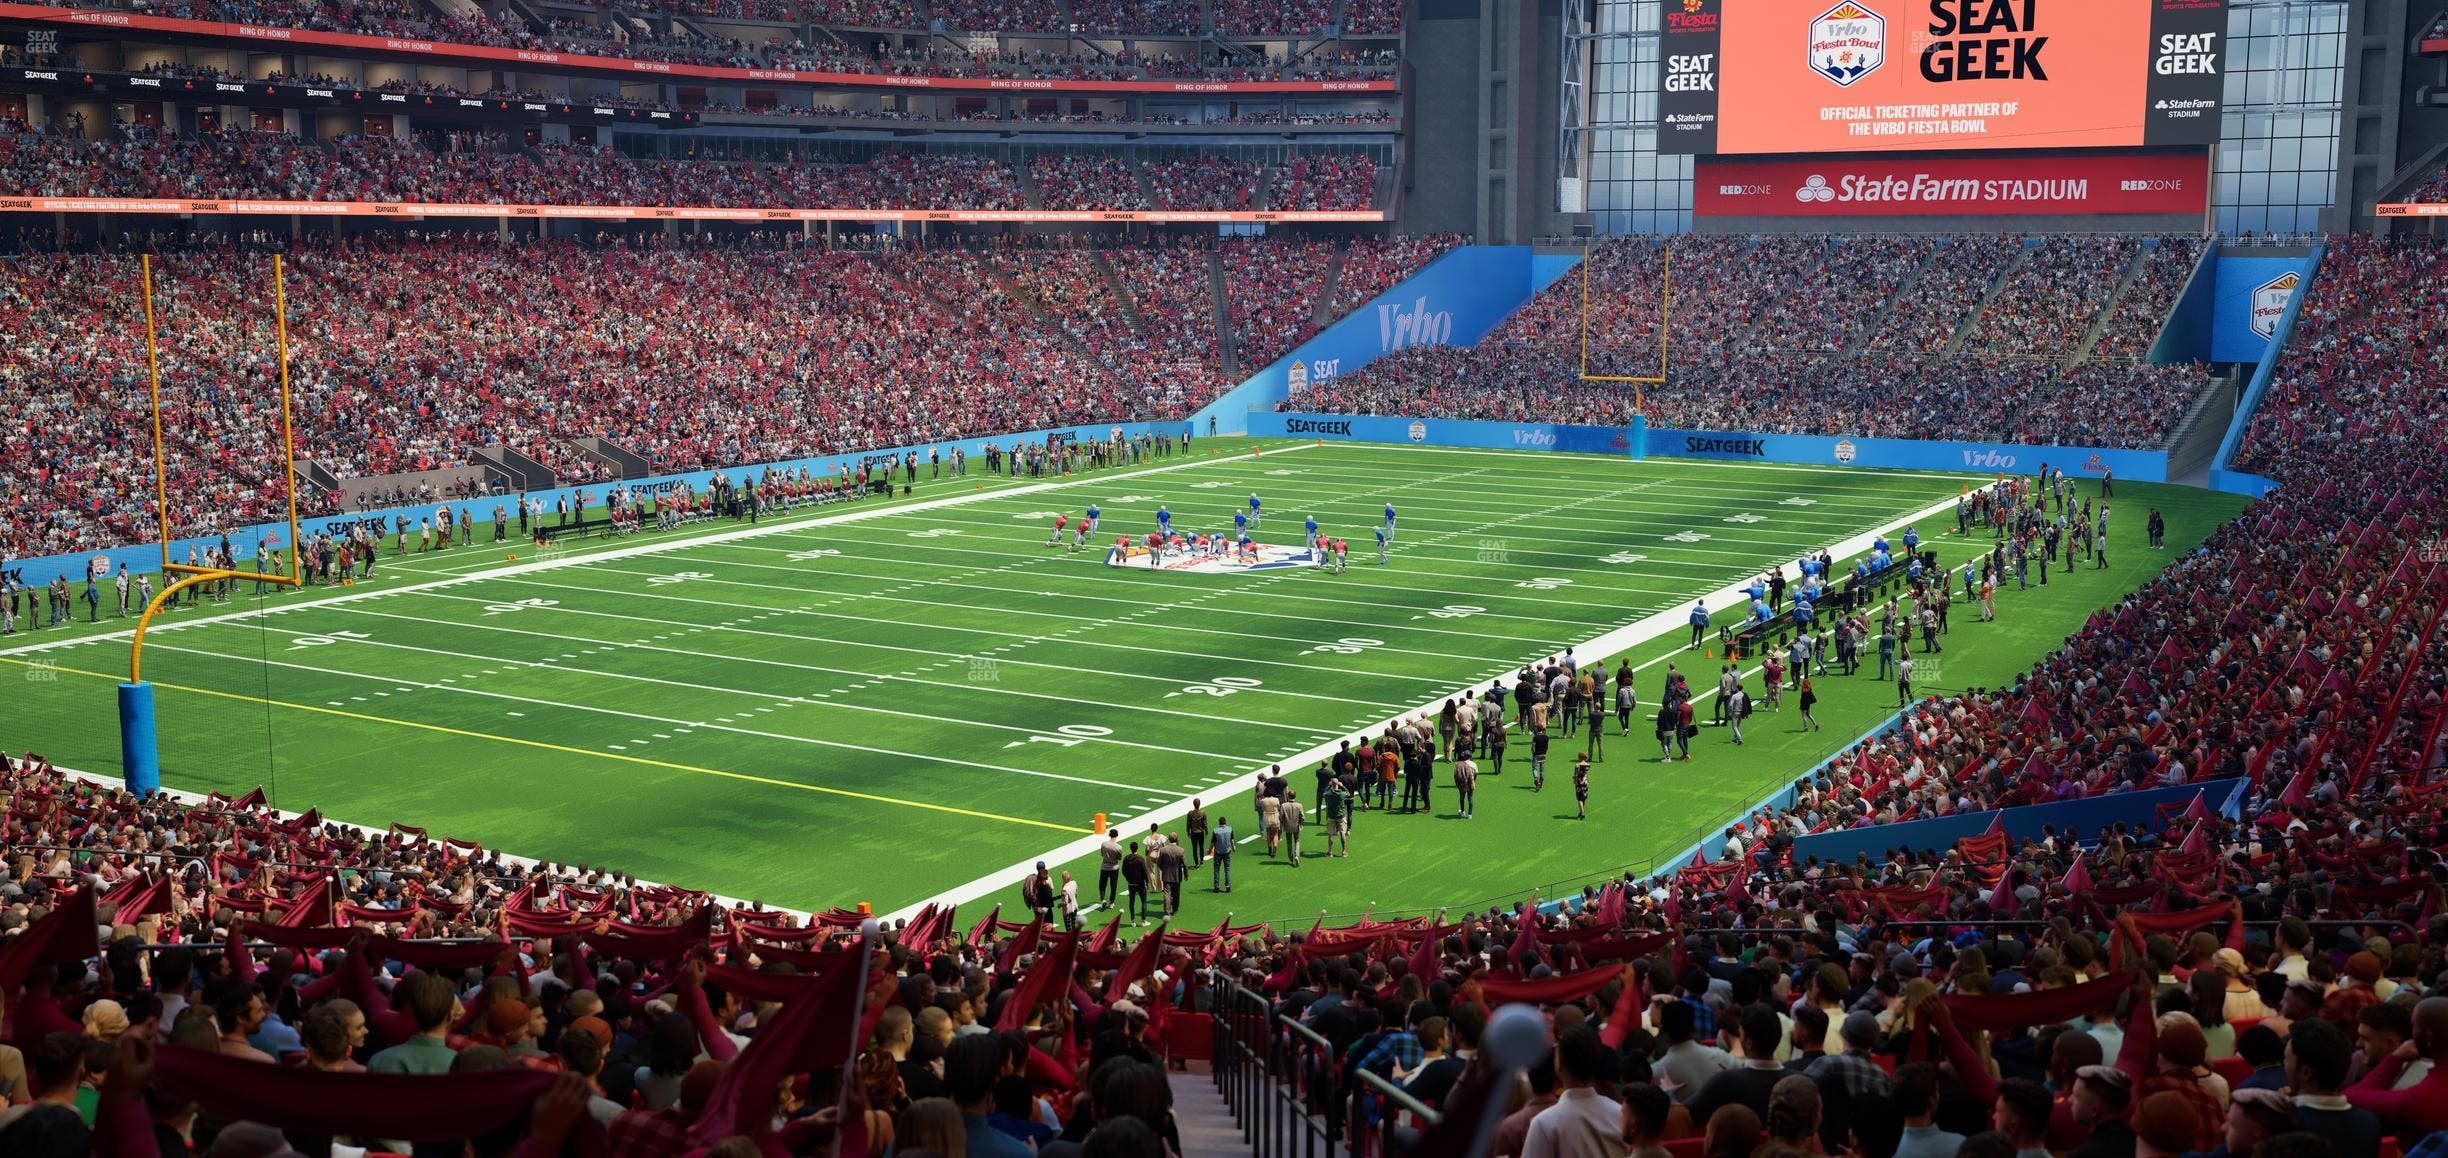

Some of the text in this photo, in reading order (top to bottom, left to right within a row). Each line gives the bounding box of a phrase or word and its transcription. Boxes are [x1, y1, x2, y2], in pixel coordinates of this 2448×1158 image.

[71, 12, 129, 25] RING OF HONOR
[1667, 12, 1718, 27] Fiesta
[1929, 0, 2036, 36] SEAT
[240, 27, 290, 38] RING OF HONOR
[1828, 22, 1867, 37] Vrbo
[388, 40, 432, 51] RING OF HONOR
[1813, 37, 1880, 53] Fiesta Bowl
[2160, 32, 2216, 54] SEAT
[518, 52, 558, 62] RING OF HONOR
[1668, 53, 1713, 74] SEAT
[1919, 37, 2049, 83] GEEK
[2156, 54, 2217, 75] GEEK
[25, 70, 58, 80] SEATGEEK
[130, 77, 160, 87] SEATGEEK
[1665, 73, 1714, 92] GEEK
[1820, 102, 2018, 121] OFFICIAL TICKETING PARTNER OF
[2168, 110, 2200, 118] STADIUM
[1676, 123, 1702, 131] STADIUM
[1848, 120, 1987, 136] THE VRBO FIESTA BOWL
[1720, 184, 1772, 195] REDZONE
[1983, 179, 2088, 201] STADIUM
[2121, 180, 2182, 191] REDZONE
[192, 203, 219, 211] SEATGEEK
[375, 205, 399, 213] SEATGEEK
[2378, 206, 2407, 214] SEATGEEK
[1378, 296, 1452, 352] Vrbo
[1314, 359, 1340, 379] SEAT
[1286, 418, 1352, 437] SEATGEEK
[1513, 429, 1556, 446] Vrbo
[1686, 436, 1765, 457] SEATGEEK
[1963, 449, 2017, 468] Vrbo
[1314, 637, 1385, 654] 30
[1182, 677, 1263, 697] 20
[1029, 724, 1114, 747] 10
